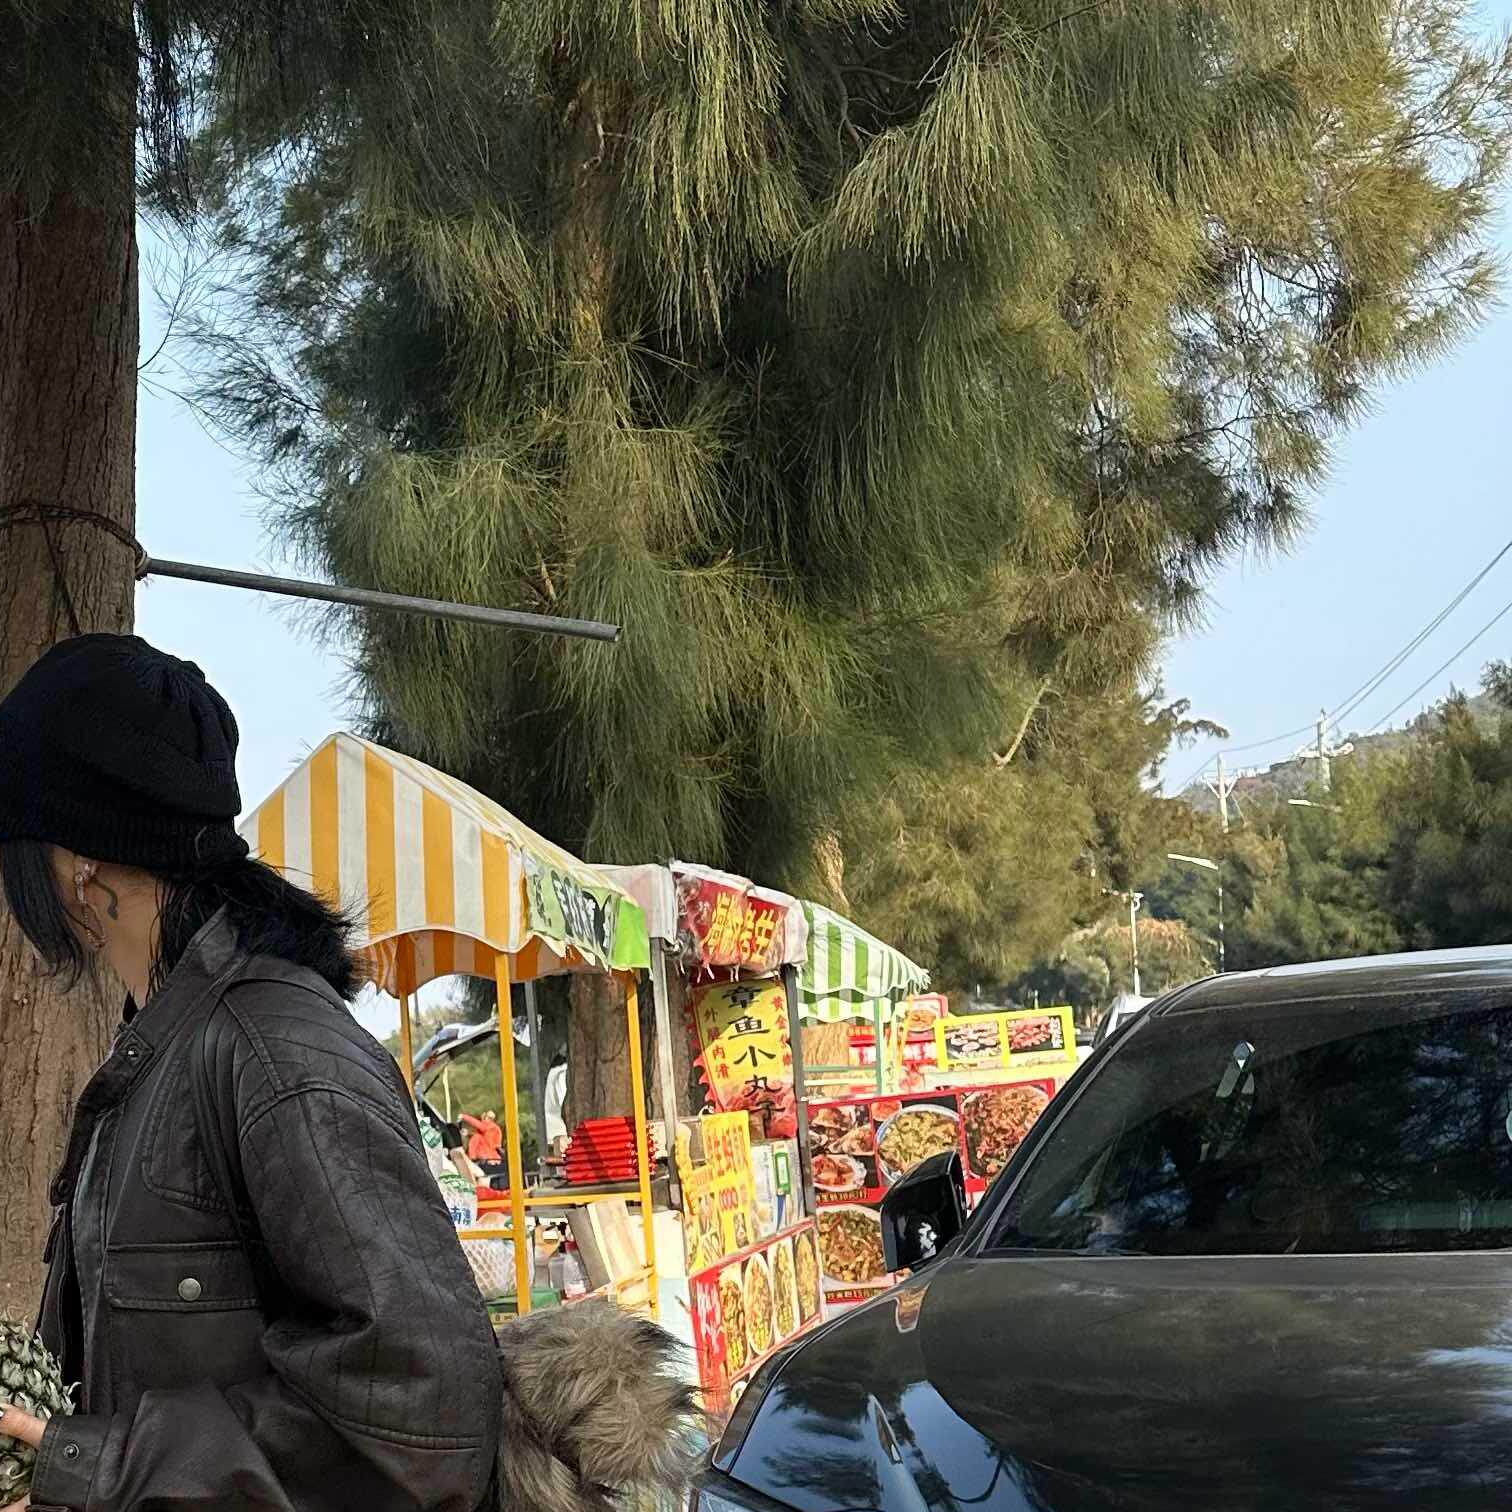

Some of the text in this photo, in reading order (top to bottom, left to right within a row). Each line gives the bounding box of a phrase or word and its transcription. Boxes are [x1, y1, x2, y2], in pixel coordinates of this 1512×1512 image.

[722, 985, 786, 1138] 章鱼小丸子
